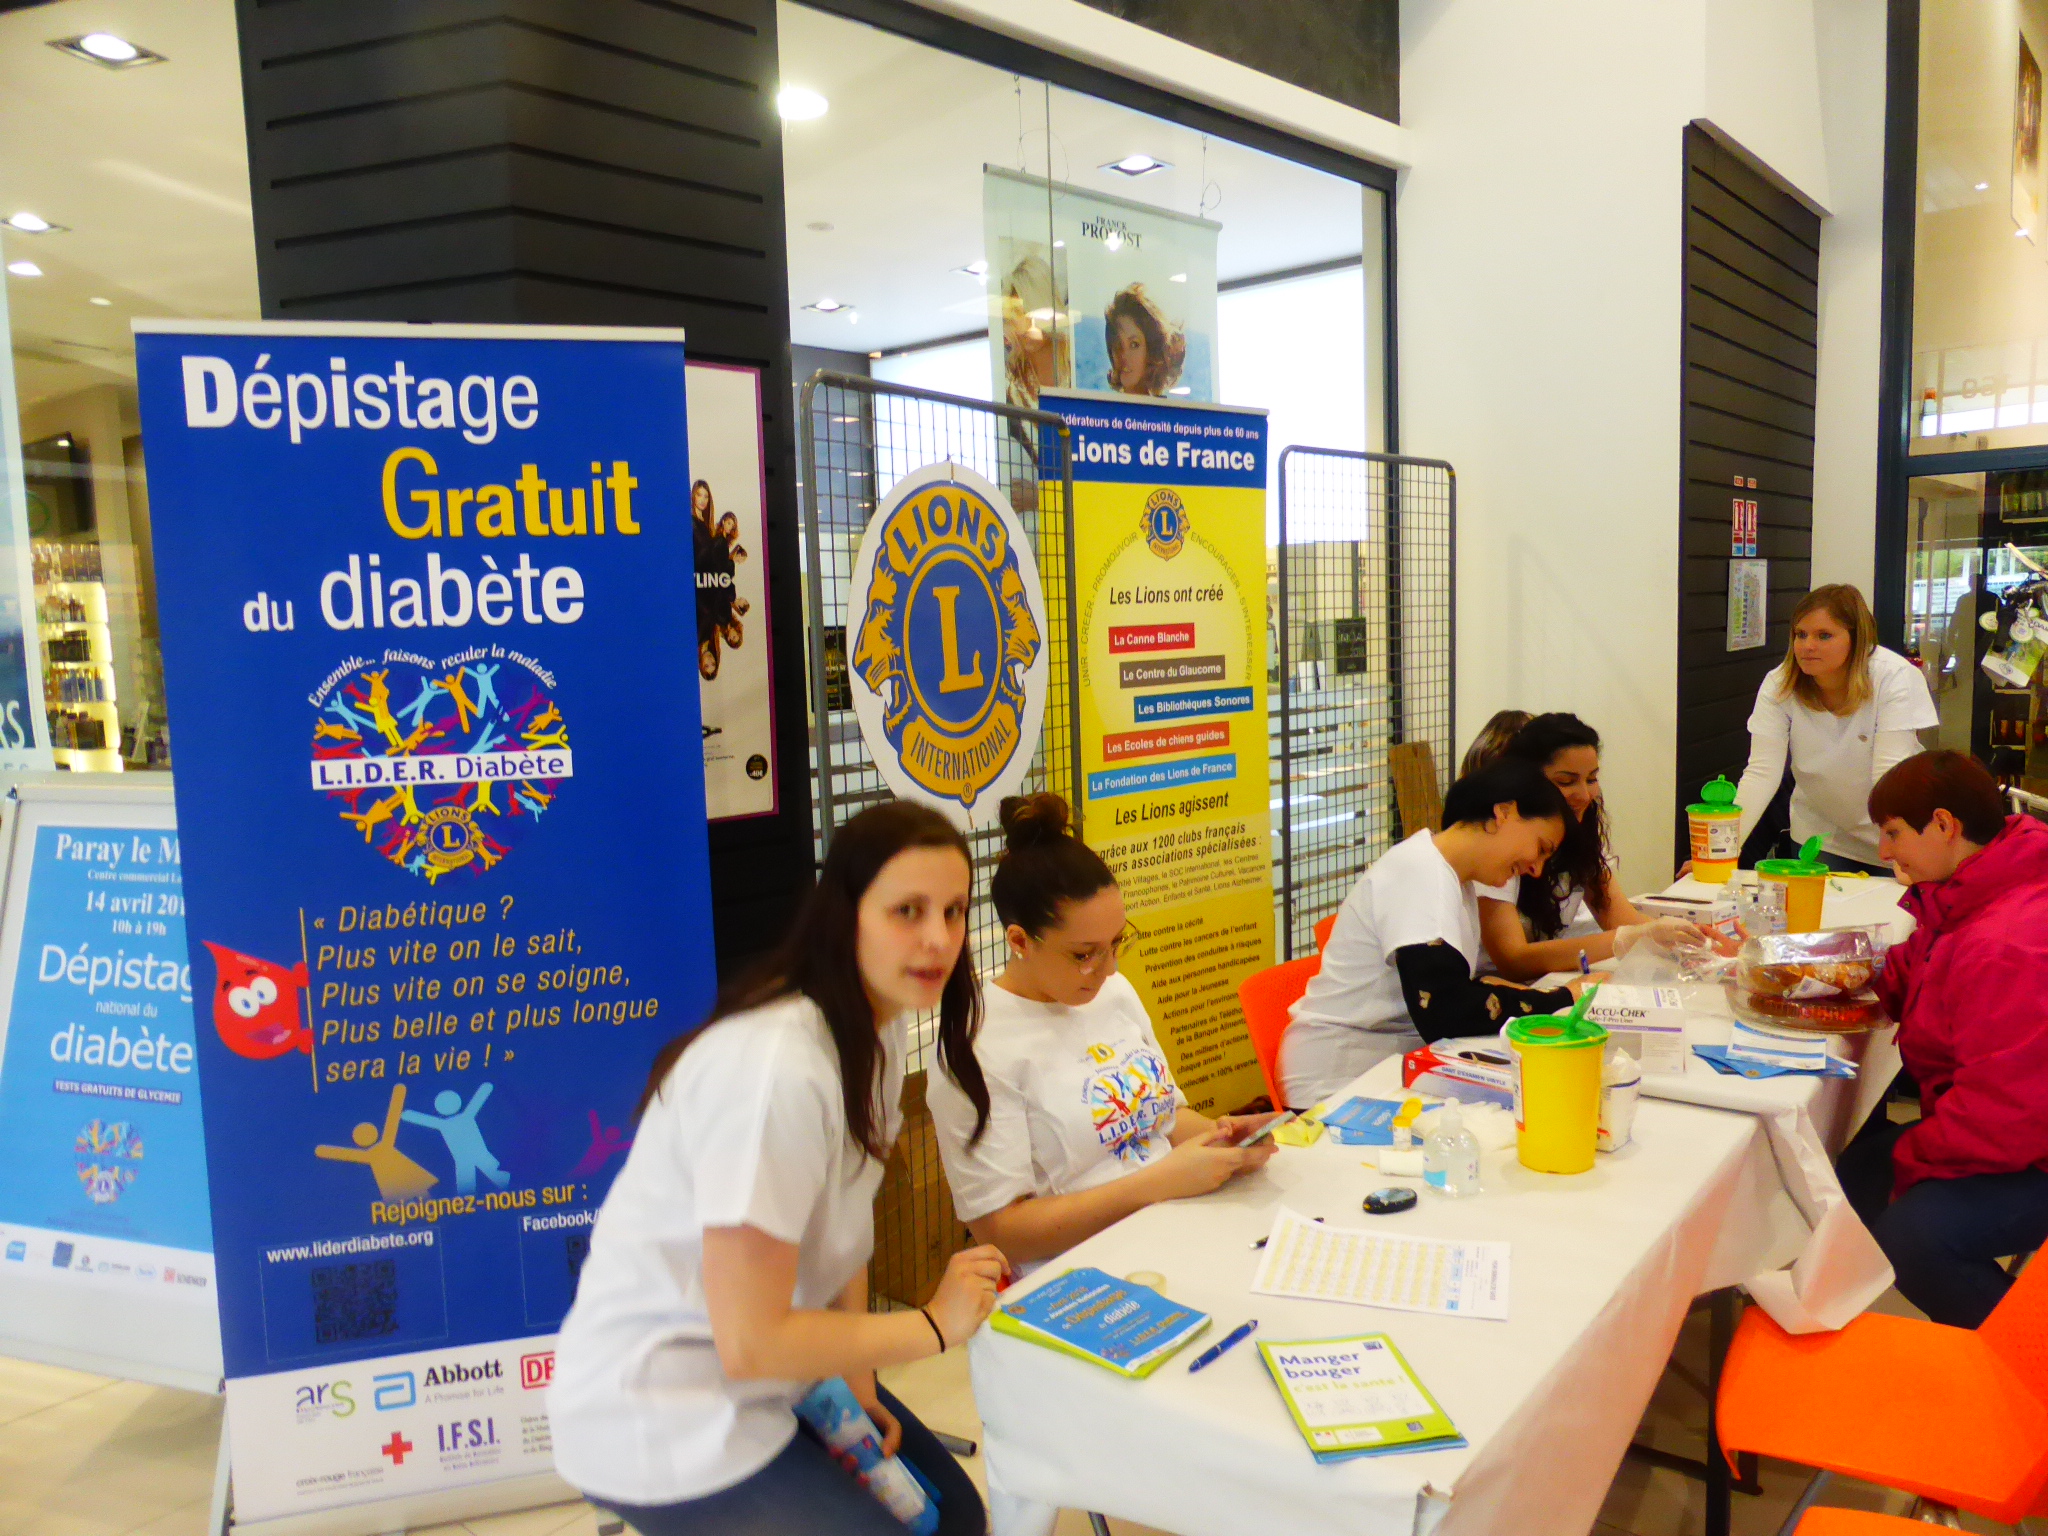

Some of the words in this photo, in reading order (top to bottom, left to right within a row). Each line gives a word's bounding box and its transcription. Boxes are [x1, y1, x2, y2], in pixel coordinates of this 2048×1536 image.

[1082, 222, 1142, 248] PROOST
[181, 353, 539, 445] Dépistage
[1059, 412, 1110, 429] édérateurs
[1112, 416, 1123, 429] de
[1125, 418, 1171, 434] Générosité
[1174, 422, 1202, 438] depuis
[1204, 425, 1221, 438] plus
[1223, 426, 1234, 438] de
[1235, 427, 1244, 438] 60
[1246, 431, 1259, 440] ans
[1139, 438, 1170, 466] de
[1176, 441, 1256, 471] France
[381, 446, 640, 540] Gratuit
[1150, 491, 1178, 507] LIONS
[892, 494, 1001, 565] LIONS
[1161, 511, 1173, 536] L
[243, 592, 294, 632] du
[319, 552, 586, 631] diabète
[693, 572, 732, 588] LING
[1110, 586, 1132, 605] Les
[1135, 586, 1170, 604] Lions
[1173, 586, 1192, 603] ont
[1195, 584, 1224, 602] créé
[932, 584, 984, 694] L
[1114, 634, 1125, 646] La
[1126, 632, 1156, 646] Canne
[1158, 629, 1190, 644] Blanche
[382, 648, 436, 670] faisons
[441, 644, 489, 670] reculer
[491, 642, 506, 658] la
[508, 650, 558, 690] maladie
[1123, 669, 1134, 682] Le
[1136, 666, 1166, 680] Centre
[1167, 666, 1178, 678] du
[1179, 664, 1222, 677] Glaucome
[1138, 702, 1155, 716] Les
[1156, 698, 1212, 714] Bibliothèques
[1214, 694, 1250, 707] Sonores
[910, 718, 1012, 781] INTERNATIONAL
[1107, 741, 1122, 754] Les
[1124, 738, 1154, 752] Ecoles
[1156, 736, 1167, 747] de
[1168, 733, 1194, 746] chiens
[1195, 730, 1225, 745] guides
[320, 760, 445, 786] L.I.D.E.R.
[456, 753, 564, 780] Diabète
[1092, 780, 1103, 792] La
[1104, 774, 1148, 790] Fondation
[1150, 772, 1166, 783] des
[1167, 767, 1190, 780] Lions
[1190, 765, 1201, 776] de
[1202, 762, 1234, 774] France
[1116, 808, 1138, 826] Les
[1141, 802, 1176, 822] Lions
[1178, 791, 1230, 816] agissent
[442, 824, 460, 848] L
[1130, 842, 1149, 855] aux
[1152, 834, 1176, 850] 1200
[1177, 829, 1202, 846] clubs
[1205, 822, 1246, 842] français
[56, 833, 126, 870] Paray
[131, 836, 152, 864] le
[1131, 849, 1194, 869] associations
[1196, 835, 1256, 858] spécialisées
[86, 890, 106, 912] 14
[110, 892, 153, 915] avril
[338, 900, 486, 932] Diabétique
[499, 895, 514, 920] ?
[1140, 946, 1158, 958] Lutte
[1160, 940, 1182, 953] contre
[1194, 932, 1220, 944] cancers
[1220, 928, 1230, 936] de
[1153, 925, 1176, 937] contre
[317, 944, 376, 970] Plus
[388, 939, 438, 966] vite
[449, 939, 480, 961] on
[493, 932, 516, 957] le
[526, 928, 583, 956] sait,
[1145, 958, 1183, 974] Prévention
[1184, 954, 1196, 964] des
[1196, 946, 1229, 960] conduites
[321, 982, 380, 1008] Plus
[392, 976, 442, 1002] vite
[452, 974, 484, 996] on
[496, 972, 526, 994] se
[536, 964, 630, 992] soigne,
[1152, 979, 1167, 990] Aide
[1168, 975, 1182, 984] aux
[1157, 994, 1174, 1005] Aide
[1174, 990, 1191, 1002] pour
[96, 1000, 140, 1017] national
[143, 1003, 158, 1018] du
[321, 1020, 380, 1046] Plus
[392, 1013, 458, 1040] belle
[469, 1008, 496, 1032] et
[506, 1003, 561, 1034] plus
[572, 996, 660, 1026] longue
[1163, 1007, 1189, 1020] Actions
[1588, 1006, 1646, 1018] ACCU-CHEK
[50, 1022, 194, 1074] diabète
[326, 1057, 386, 1084] sera
[398, 1050, 421, 1076] la
[434, 1046, 471, 1073] vie
[482, 1042, 492, 1068] !
[55, 1080, 80, 1094] TESTS
[81, 1082, 123, 1098] GRATUITS
[124, 1086, 136, 1098] DE
[138, 1086, 182, 1104] GLYCEMIE
[370, 1184, 537, 1226] Rejoignez-nous
[542, 1183, 576, 1206] sur
[522, 1208, 602, 1232] Facebook/
[266, 1228, 434, 1264] www.liderdiabete.org
[423, 1358, 504, 1388] Abbott
[1279, 1353, 1360, 1366] Manger
[1284, 1366, 1360, 1380] bouger
[296, 1379, 356, 1418] ars
[1332, 1380, 1349, 1390] la
[1352, 1378, 1395, 1389] santé
[438, 1417, 500, 1452] I.F.S.I.
